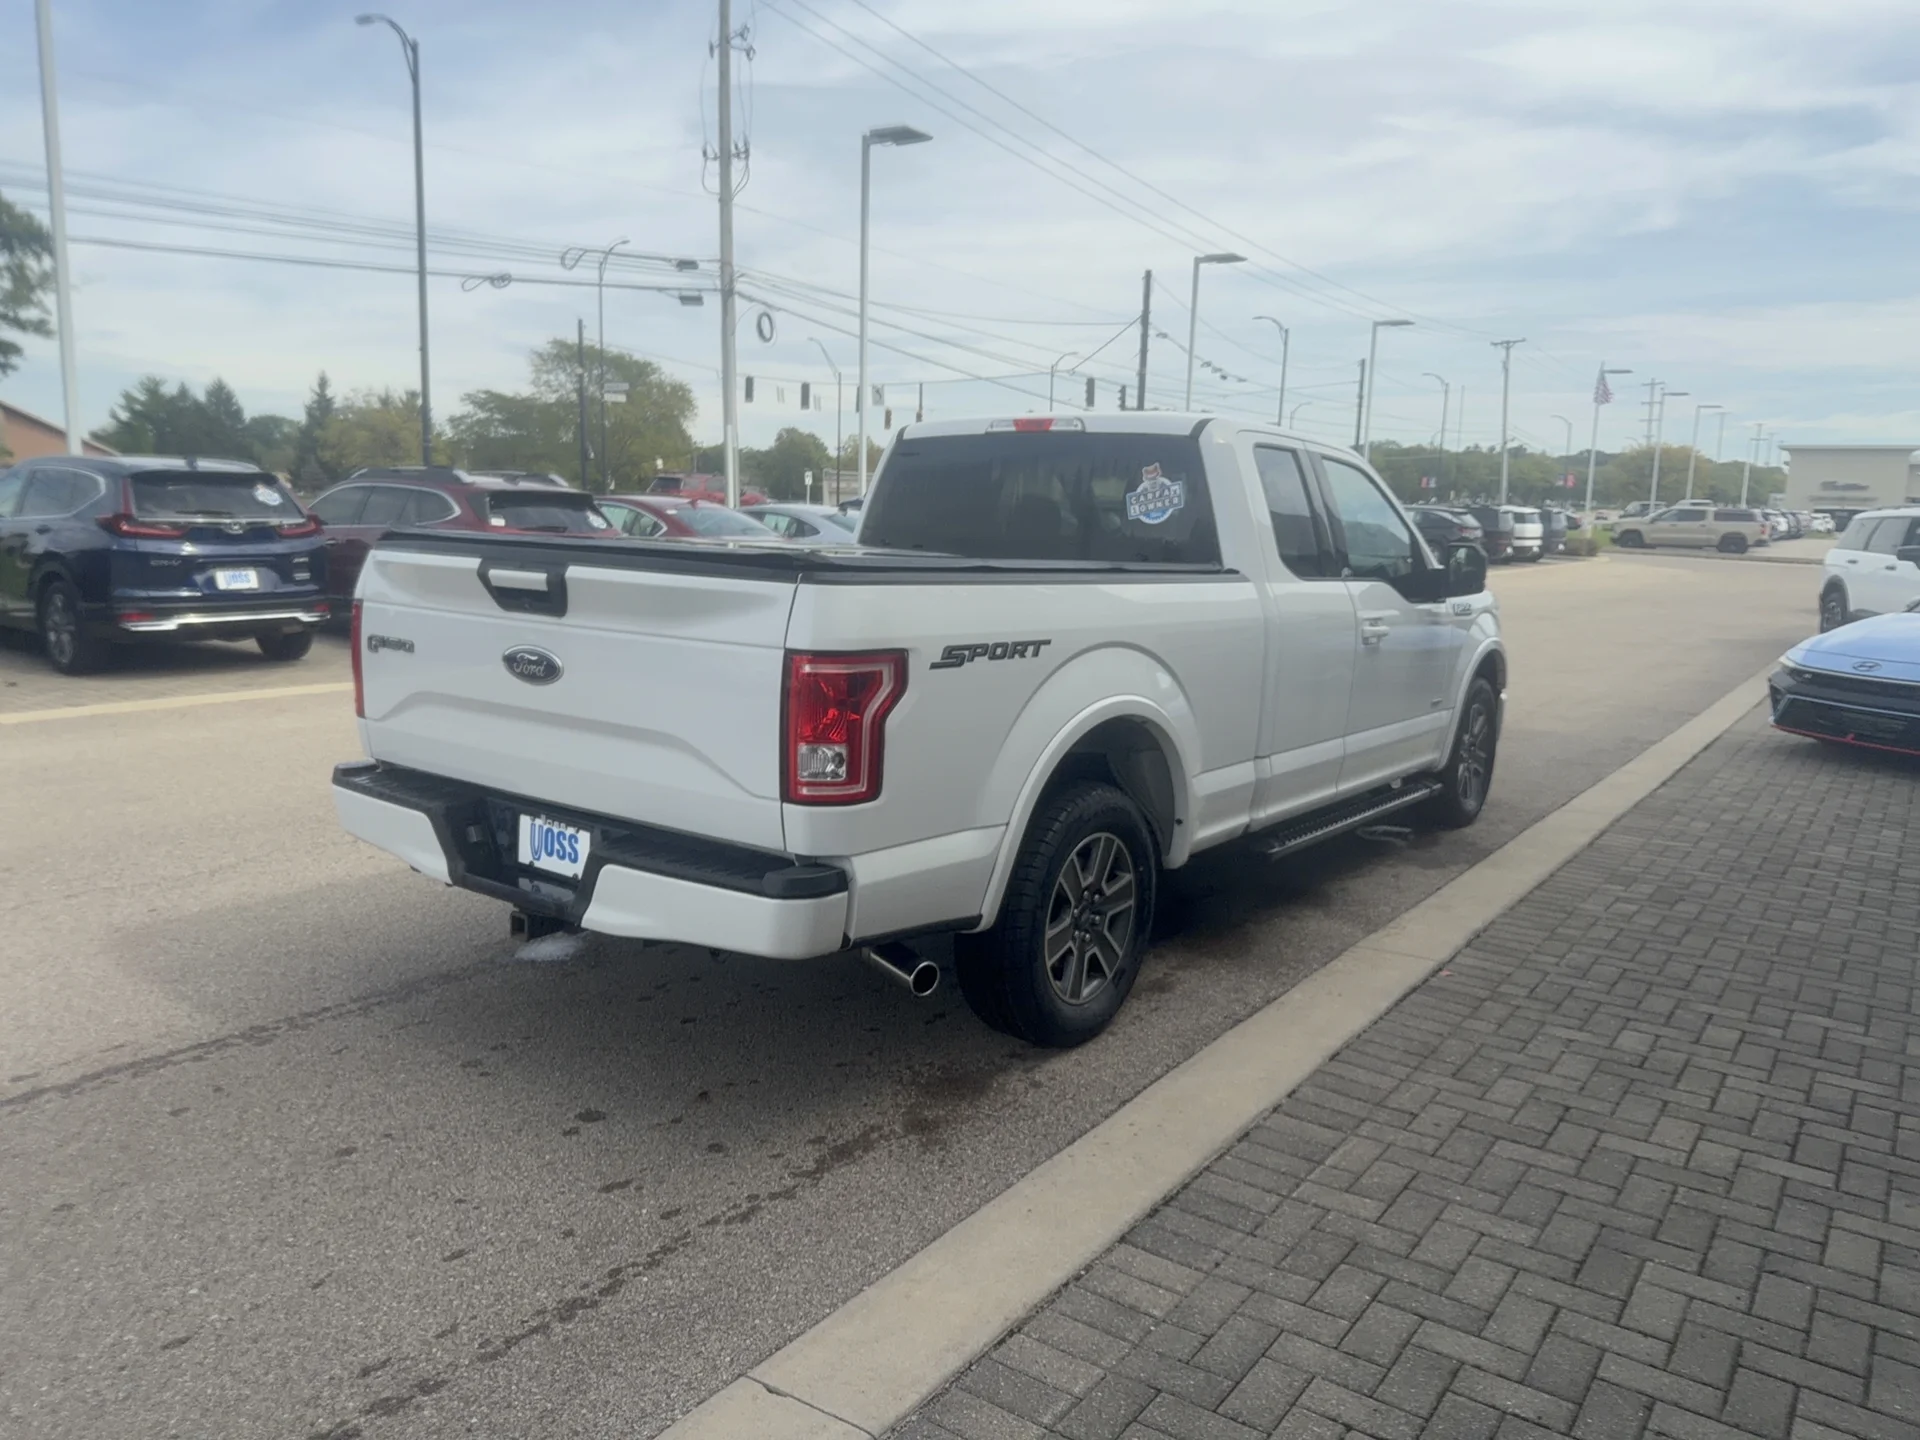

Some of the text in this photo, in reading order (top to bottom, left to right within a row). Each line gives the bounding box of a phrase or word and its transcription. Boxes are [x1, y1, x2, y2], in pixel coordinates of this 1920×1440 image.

[1130, 484, 1180, 504] CARFAX
[1140, 497, 1178, 513] OWNER
[513, 652, 547, 677] Ford
[929, 639, 1052, 670] SPORT
